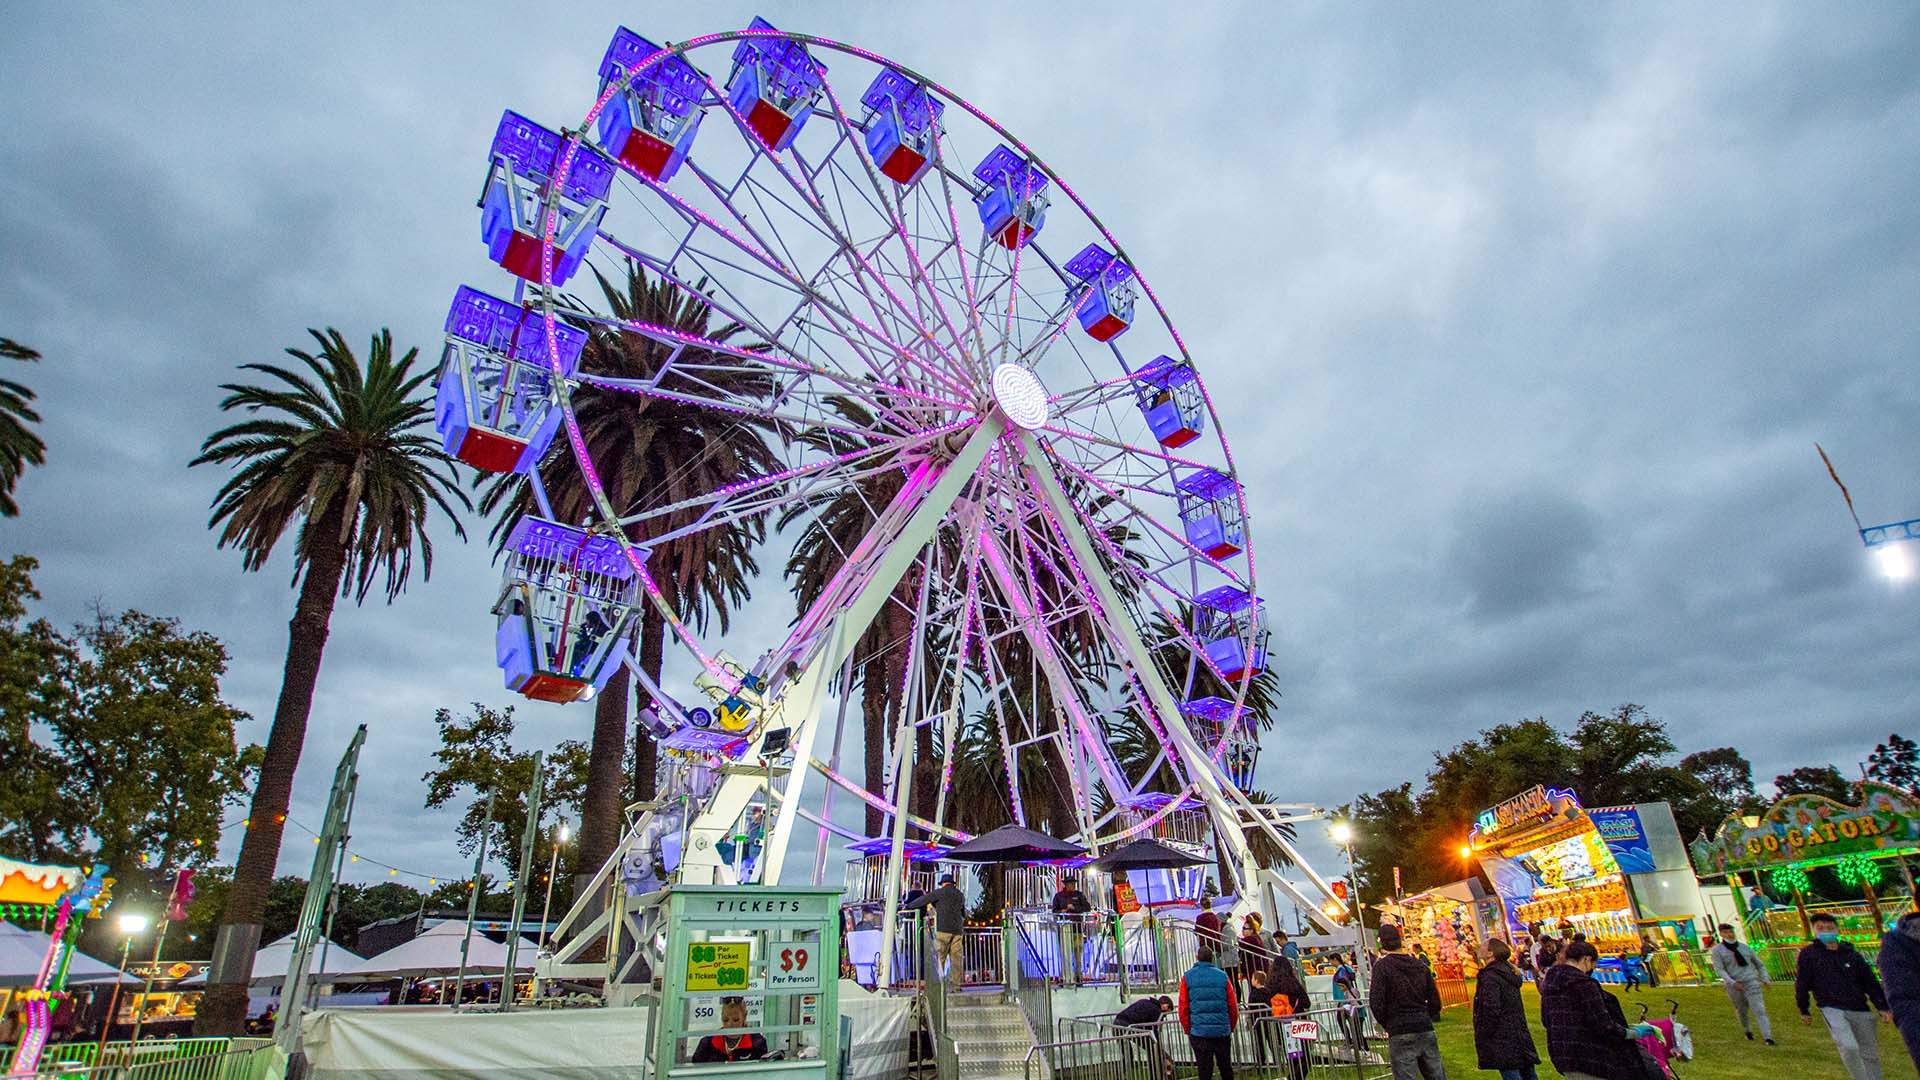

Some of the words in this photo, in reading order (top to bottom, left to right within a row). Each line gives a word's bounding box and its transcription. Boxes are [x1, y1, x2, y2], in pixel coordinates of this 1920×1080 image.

[716, 900, 800, 912] TICKETS
[780, 947, 808, 972] $9
[127, 966, 161, 975] DONUS
[772, 975, 786, 984] Per
[787, 975, 815, 983] Person
[694, 1007, 714, 1019] $50
[1292, 1023, 1317, 1034] ENTRY
